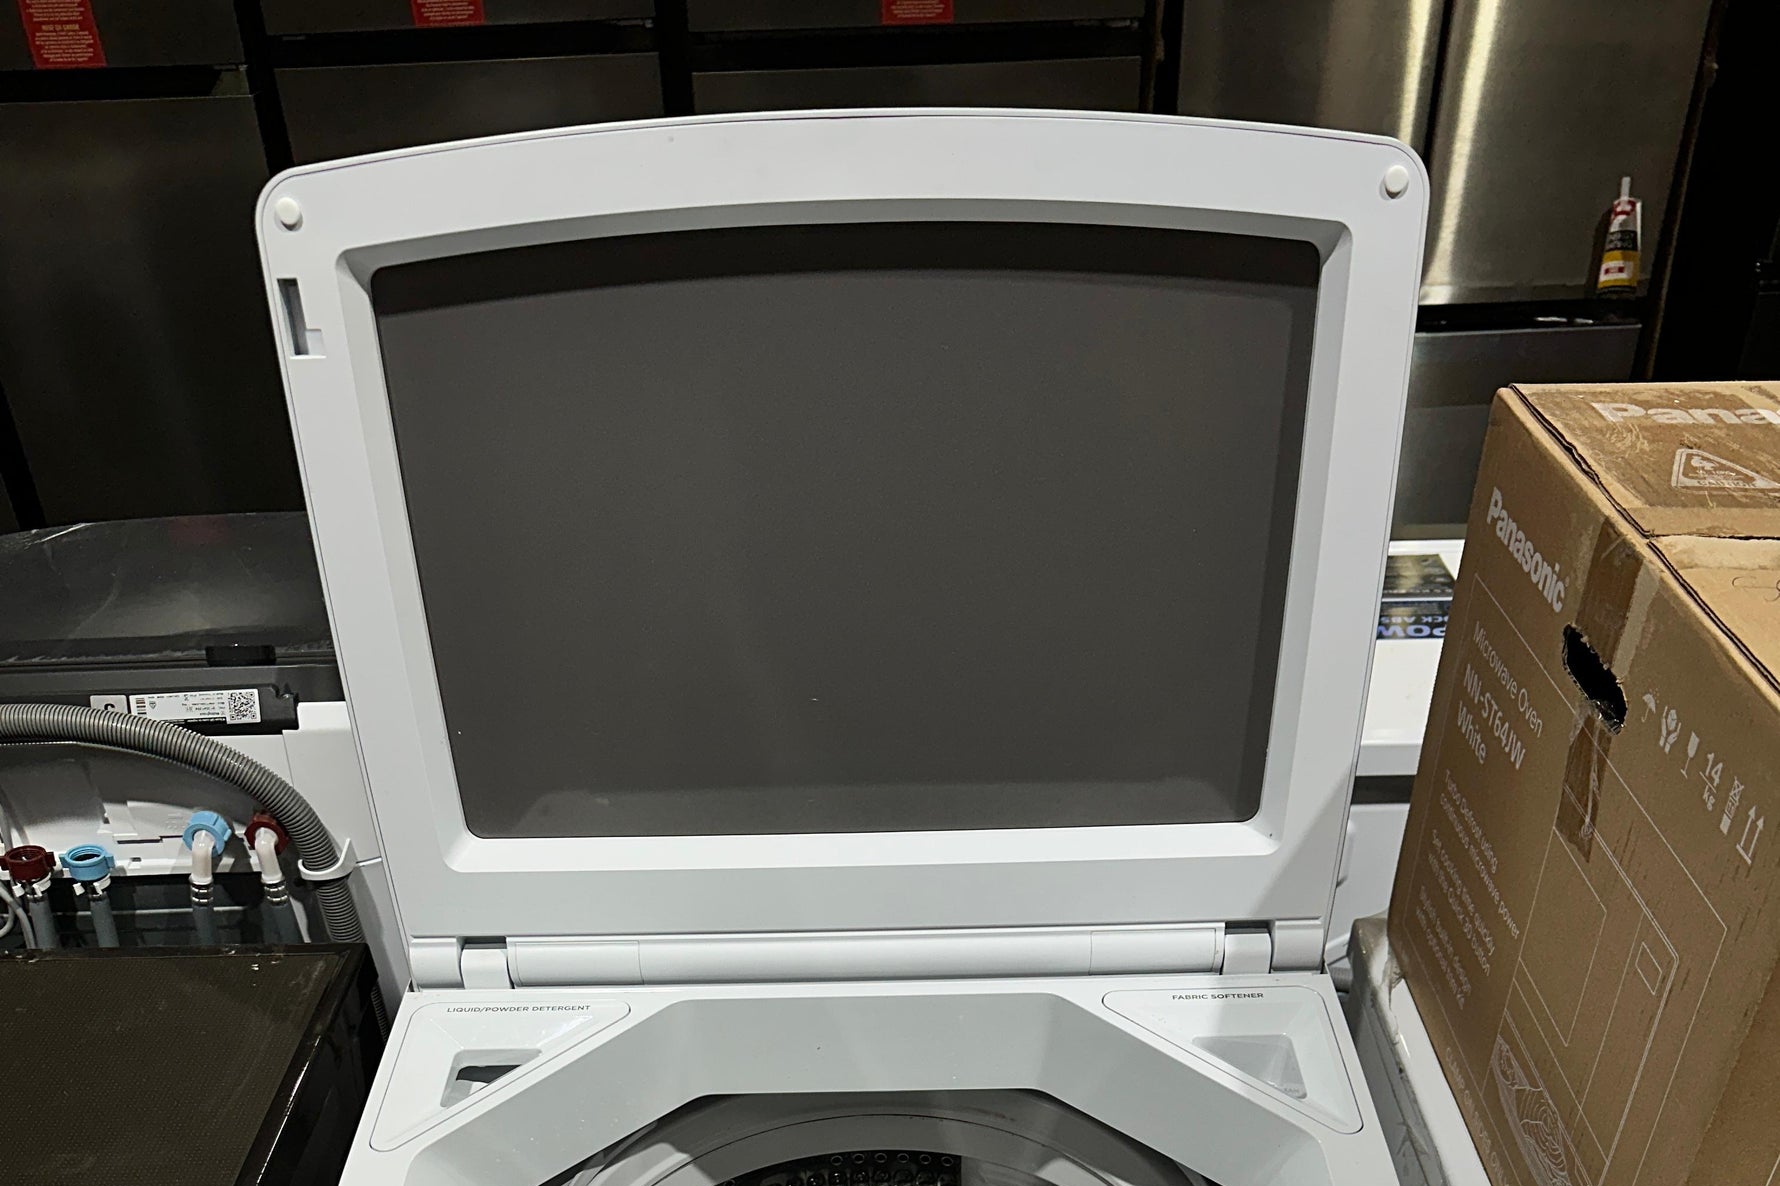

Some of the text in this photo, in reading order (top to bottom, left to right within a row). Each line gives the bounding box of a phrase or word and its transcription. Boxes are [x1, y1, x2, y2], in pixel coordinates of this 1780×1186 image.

[1590, 402, 1780, 425] Pana
[1487, 487, 1568, 613] Panasonic
[1474, 621, 1543, 738] Microwave Oven
[1458, 701, 1487, 764] White
[1464, 664, 1526, 770] NN-ST64JW
[1706, 753, 1723, 786] 14
[1481, 837, 1498, 873] using
[1470, 845, 1499, 904] microwave
[1498, 901, 1519, 939] power
[1474, 912, 1495, 956] quickly
[1211, 992, 1264, 1000] SOFTENER
